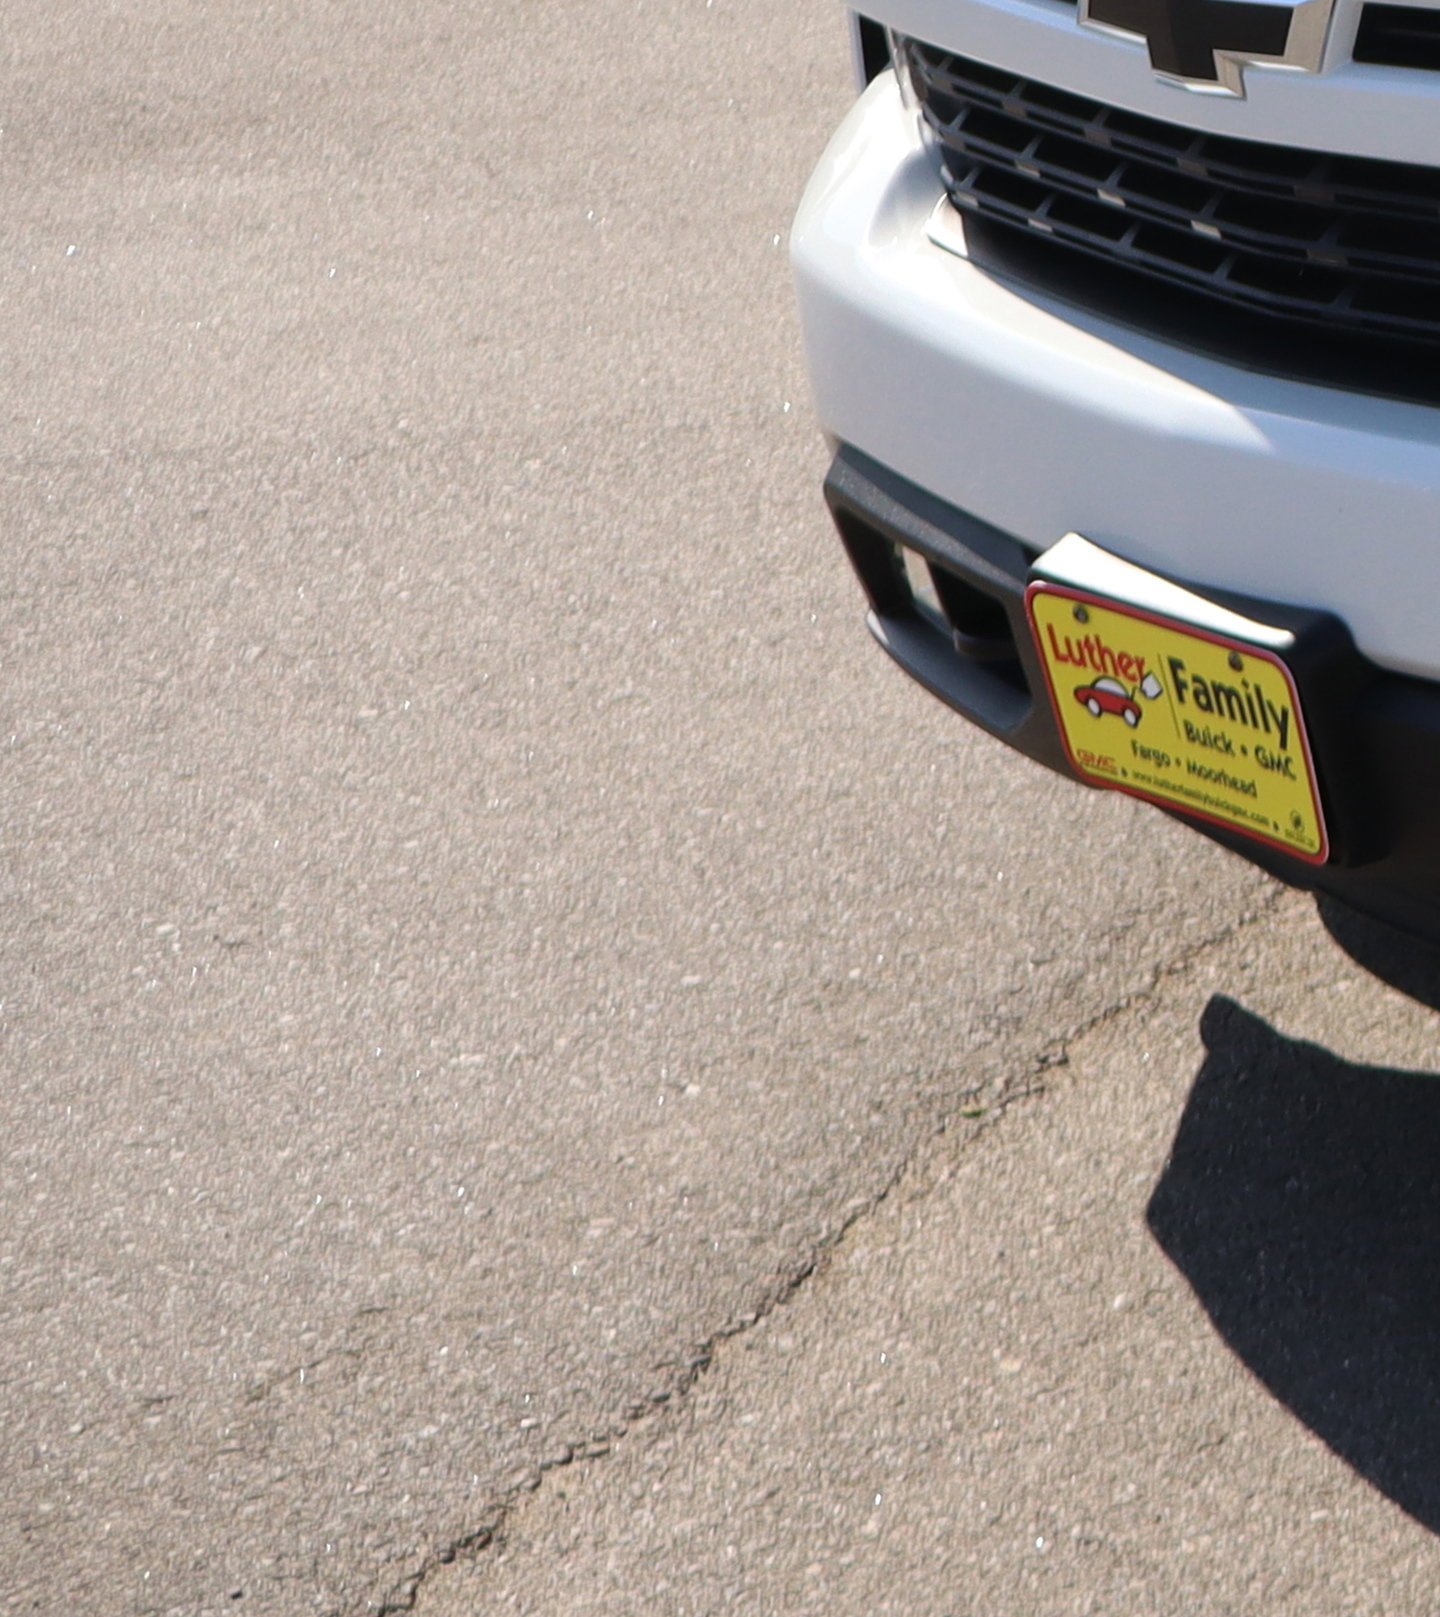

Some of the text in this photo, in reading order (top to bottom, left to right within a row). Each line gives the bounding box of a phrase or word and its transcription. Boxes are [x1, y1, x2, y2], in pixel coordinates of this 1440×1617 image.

[1046, 622, 1290, 751] Luther Family
[1131, 739, 1258, 799] Fargo Moorhead
[1183, 719, 1297, 781] Buick GMC
